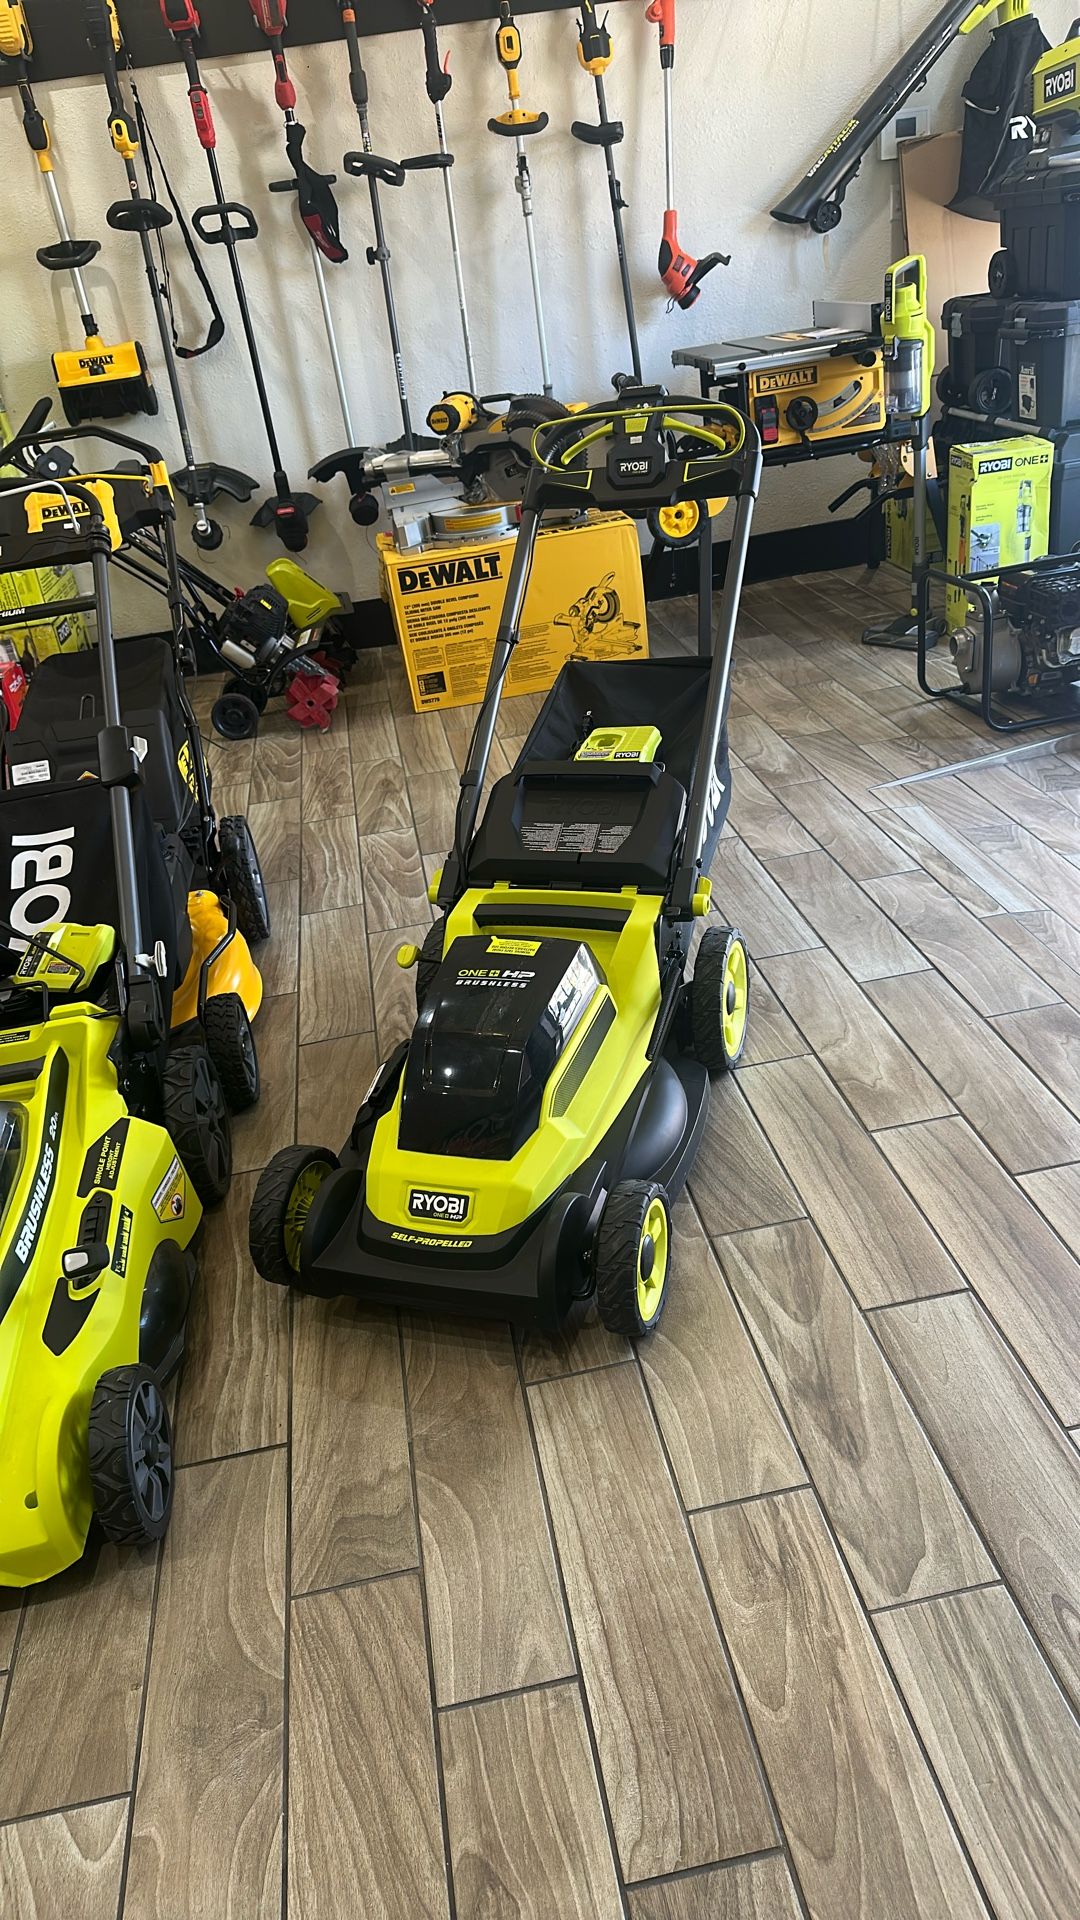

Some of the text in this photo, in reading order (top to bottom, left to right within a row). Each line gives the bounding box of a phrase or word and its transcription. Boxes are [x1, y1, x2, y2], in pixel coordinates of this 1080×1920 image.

[1045, 69, 1074, 97] RYOBI
[807, 119, 856, 177] VACATTACK
[79, 354, 114, 369] DEWALT
[760, 370, 814, 389] DEWALT
[620, 461, 648, 472] RYOBI
[980, 458, 1012, 473] RYOBI
[1015, 454, 1049, 467] ONE+
[42, 502, 89, 520] DEWAL
[398, 555, 501, 592] DEWALT
[455, 980, 527, 988] BRUSHLESS
[502, 970, 535, 979] HP
[94, 1135, 111, 1185] SINGLE POINT
[108, 1141, 121, 1180] ADJUSTMENT
[15, 1143, 54, 1264] BRUSHLESS
[412, 1193, 465, 1214] RYOBI
[391, 1232, 473, 1248] SELF-PROPELLED
